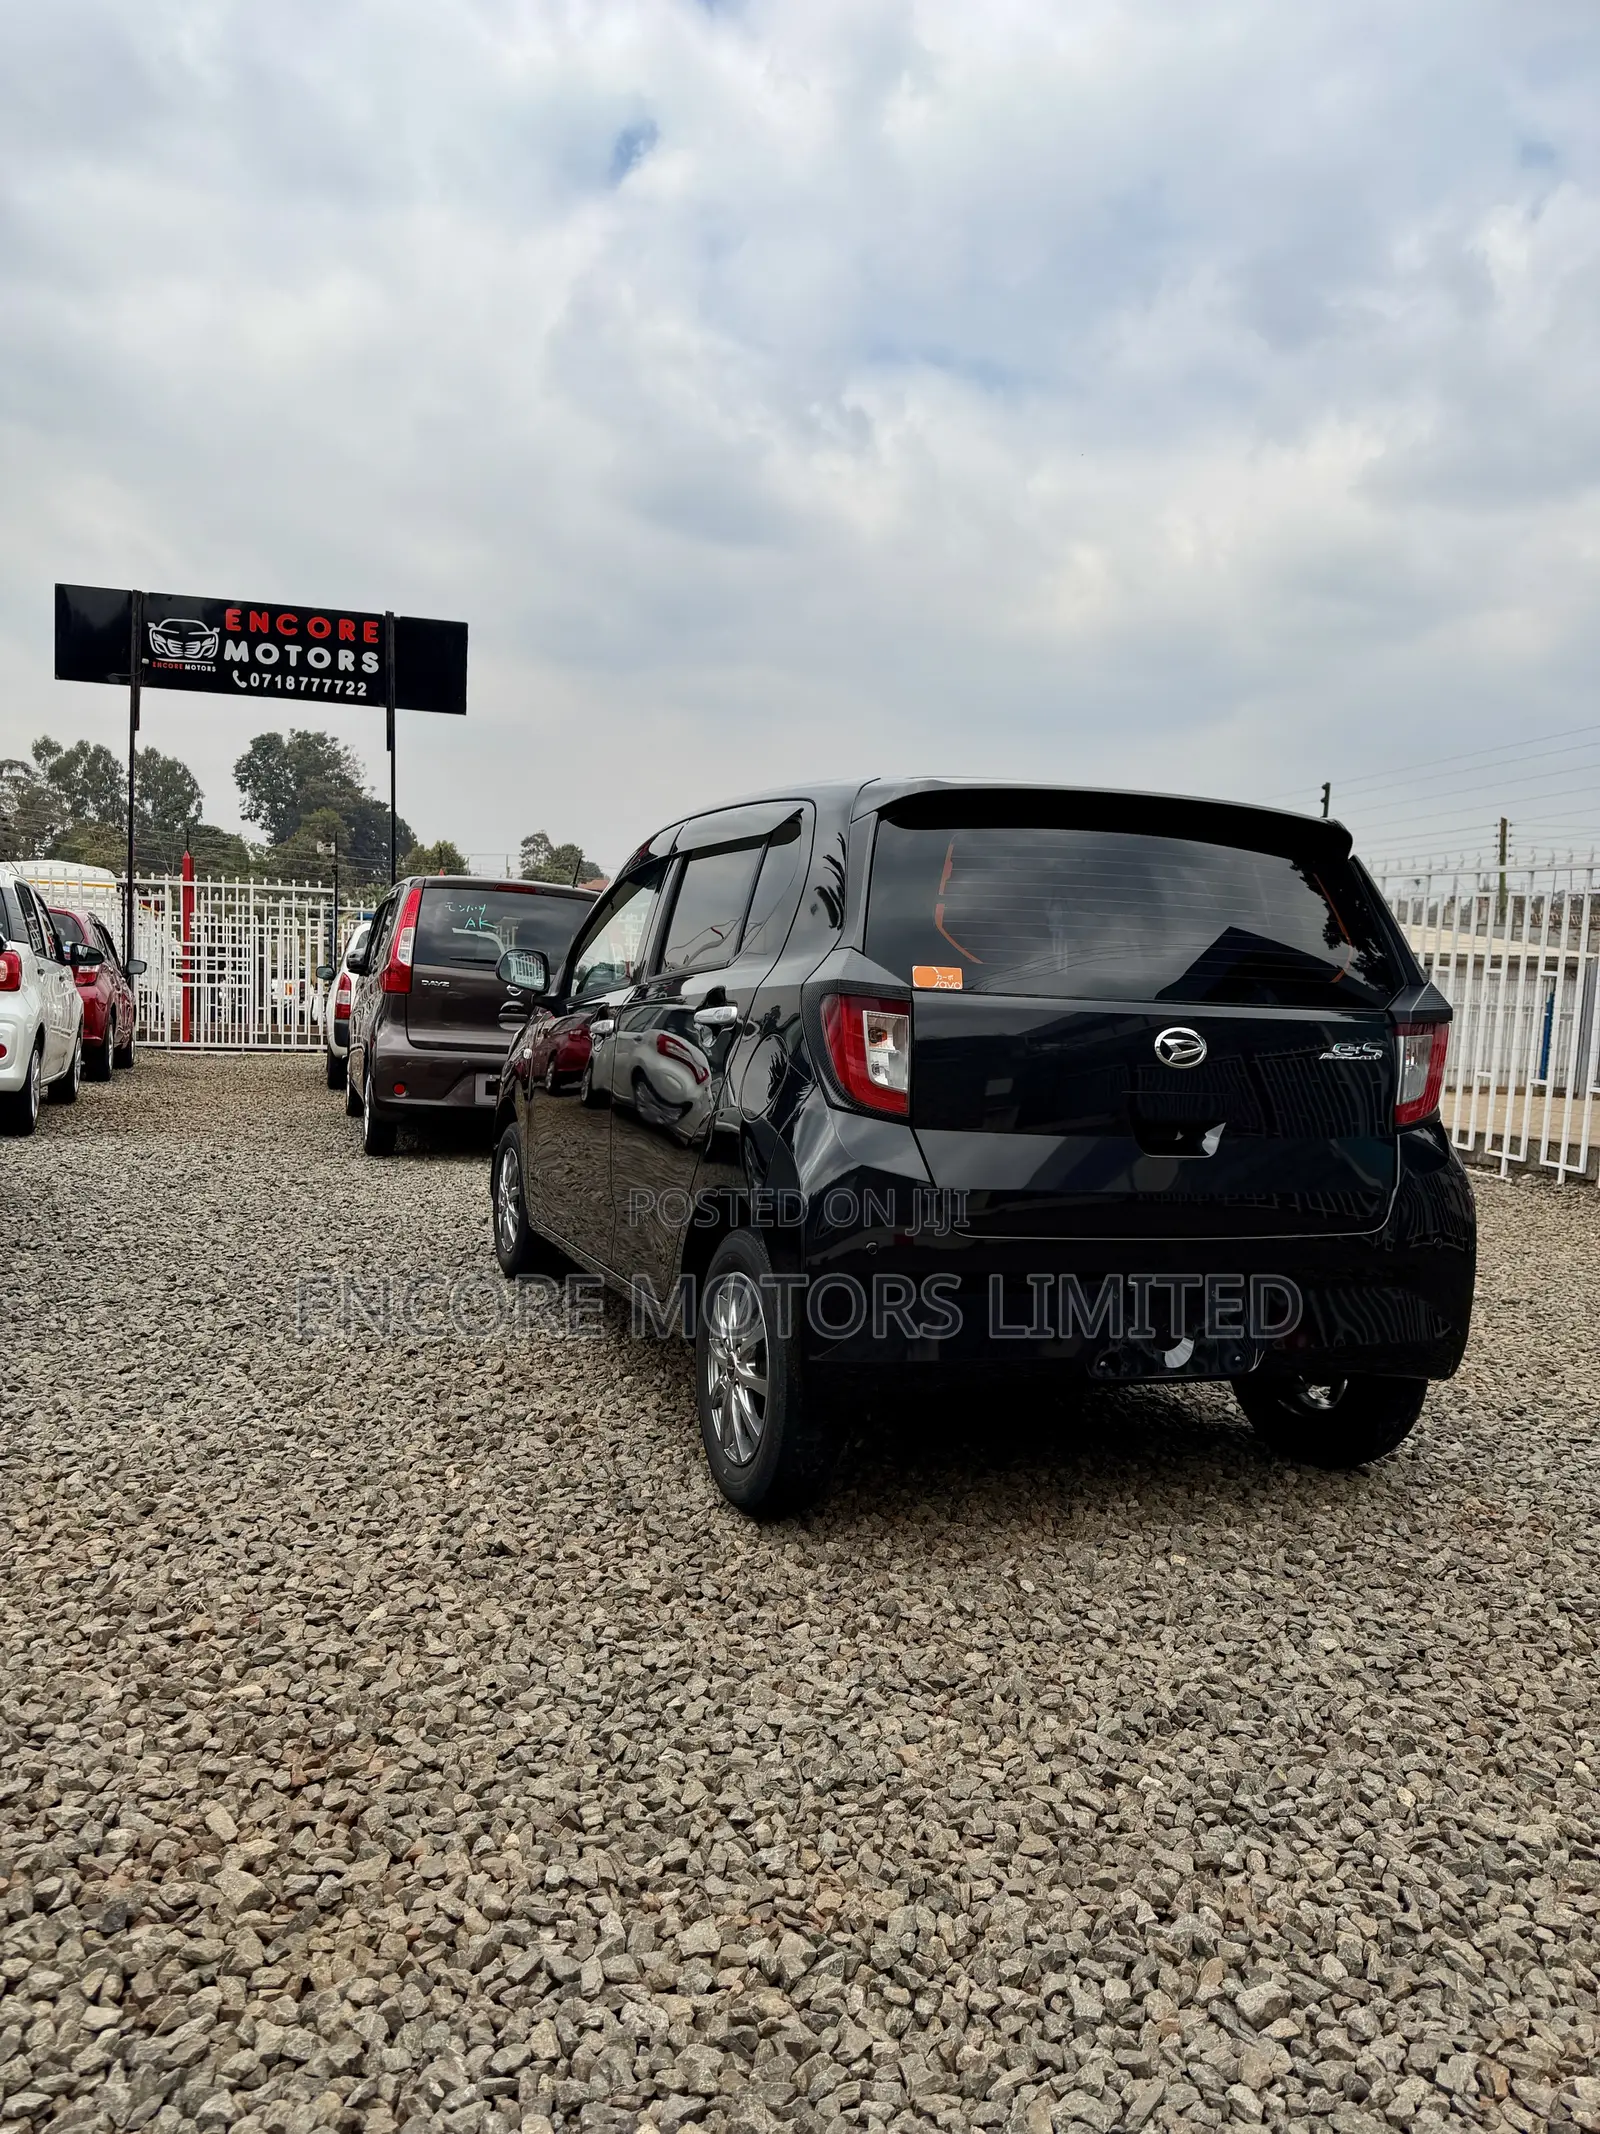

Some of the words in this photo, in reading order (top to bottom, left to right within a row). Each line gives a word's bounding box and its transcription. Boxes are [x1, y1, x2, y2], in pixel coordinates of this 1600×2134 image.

[225, 608, 379, 643] ENCORE
[152, 661, 184, 670] ENCORE
[184, 663, 217, 672] MOTORS
[223, 639, 380, 674] MOTORS
[250, 672, 367, 697] 0718777722
